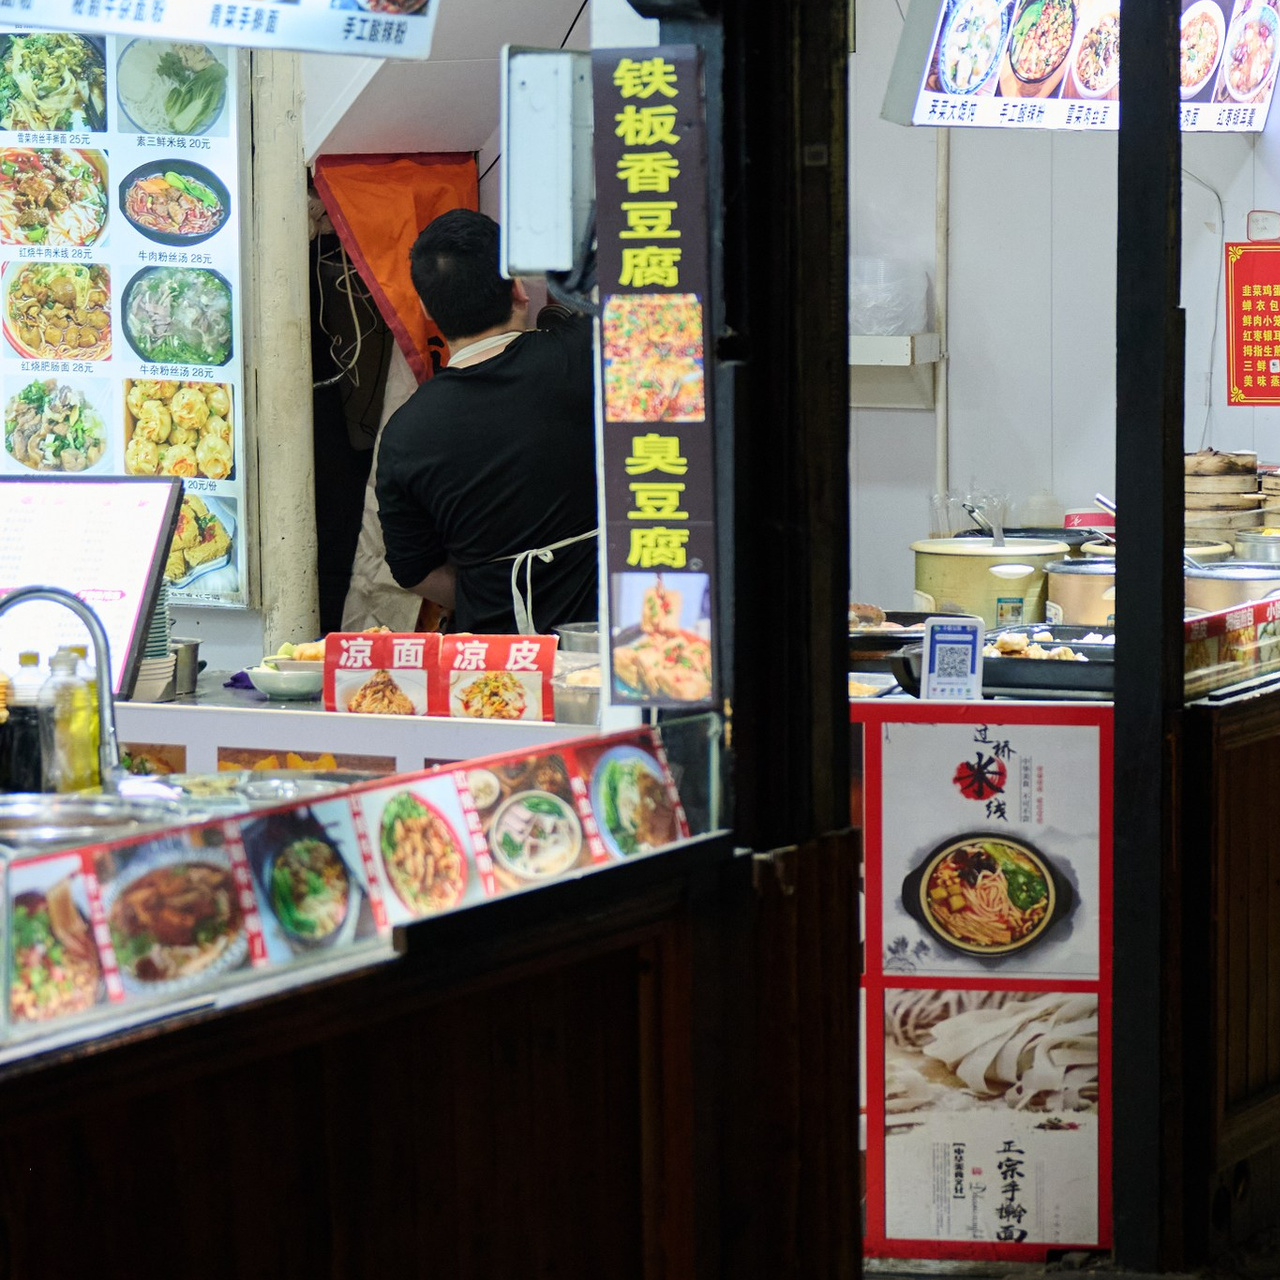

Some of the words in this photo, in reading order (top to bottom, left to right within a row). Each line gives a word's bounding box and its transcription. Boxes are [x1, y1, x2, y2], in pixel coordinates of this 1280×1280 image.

[69, 134, 91, 145] 25元
[136, 136, 187, 149] 素三鲜米线
[189, 137, 211, 150] 20元
[613, 57, 683, 288] 铁板香豆腐
[19, 247, 69, 259] 红烧牛肉米线
[71, 248, 93, 260] 28元
[138, 250, 188, 263] 牛肉粉丝汤
[191, 252, 213, 264] 28元
[20, 360, 70, 372] 红烧肥肠面
[72, 361, 94, 373] 28元
[139, 365, 189, 377] 牛杂粉丝汤
[192, 367, 214, 379] 28元
[187, 480, 217, 492] 20元/份
[624, 433, 690, 569] 臭豆腐
[339, 637, 427, 670] 凉面
[453, 639, 542, 673] 凉皮
[953, 723, 1018, 822] 过桥米线
